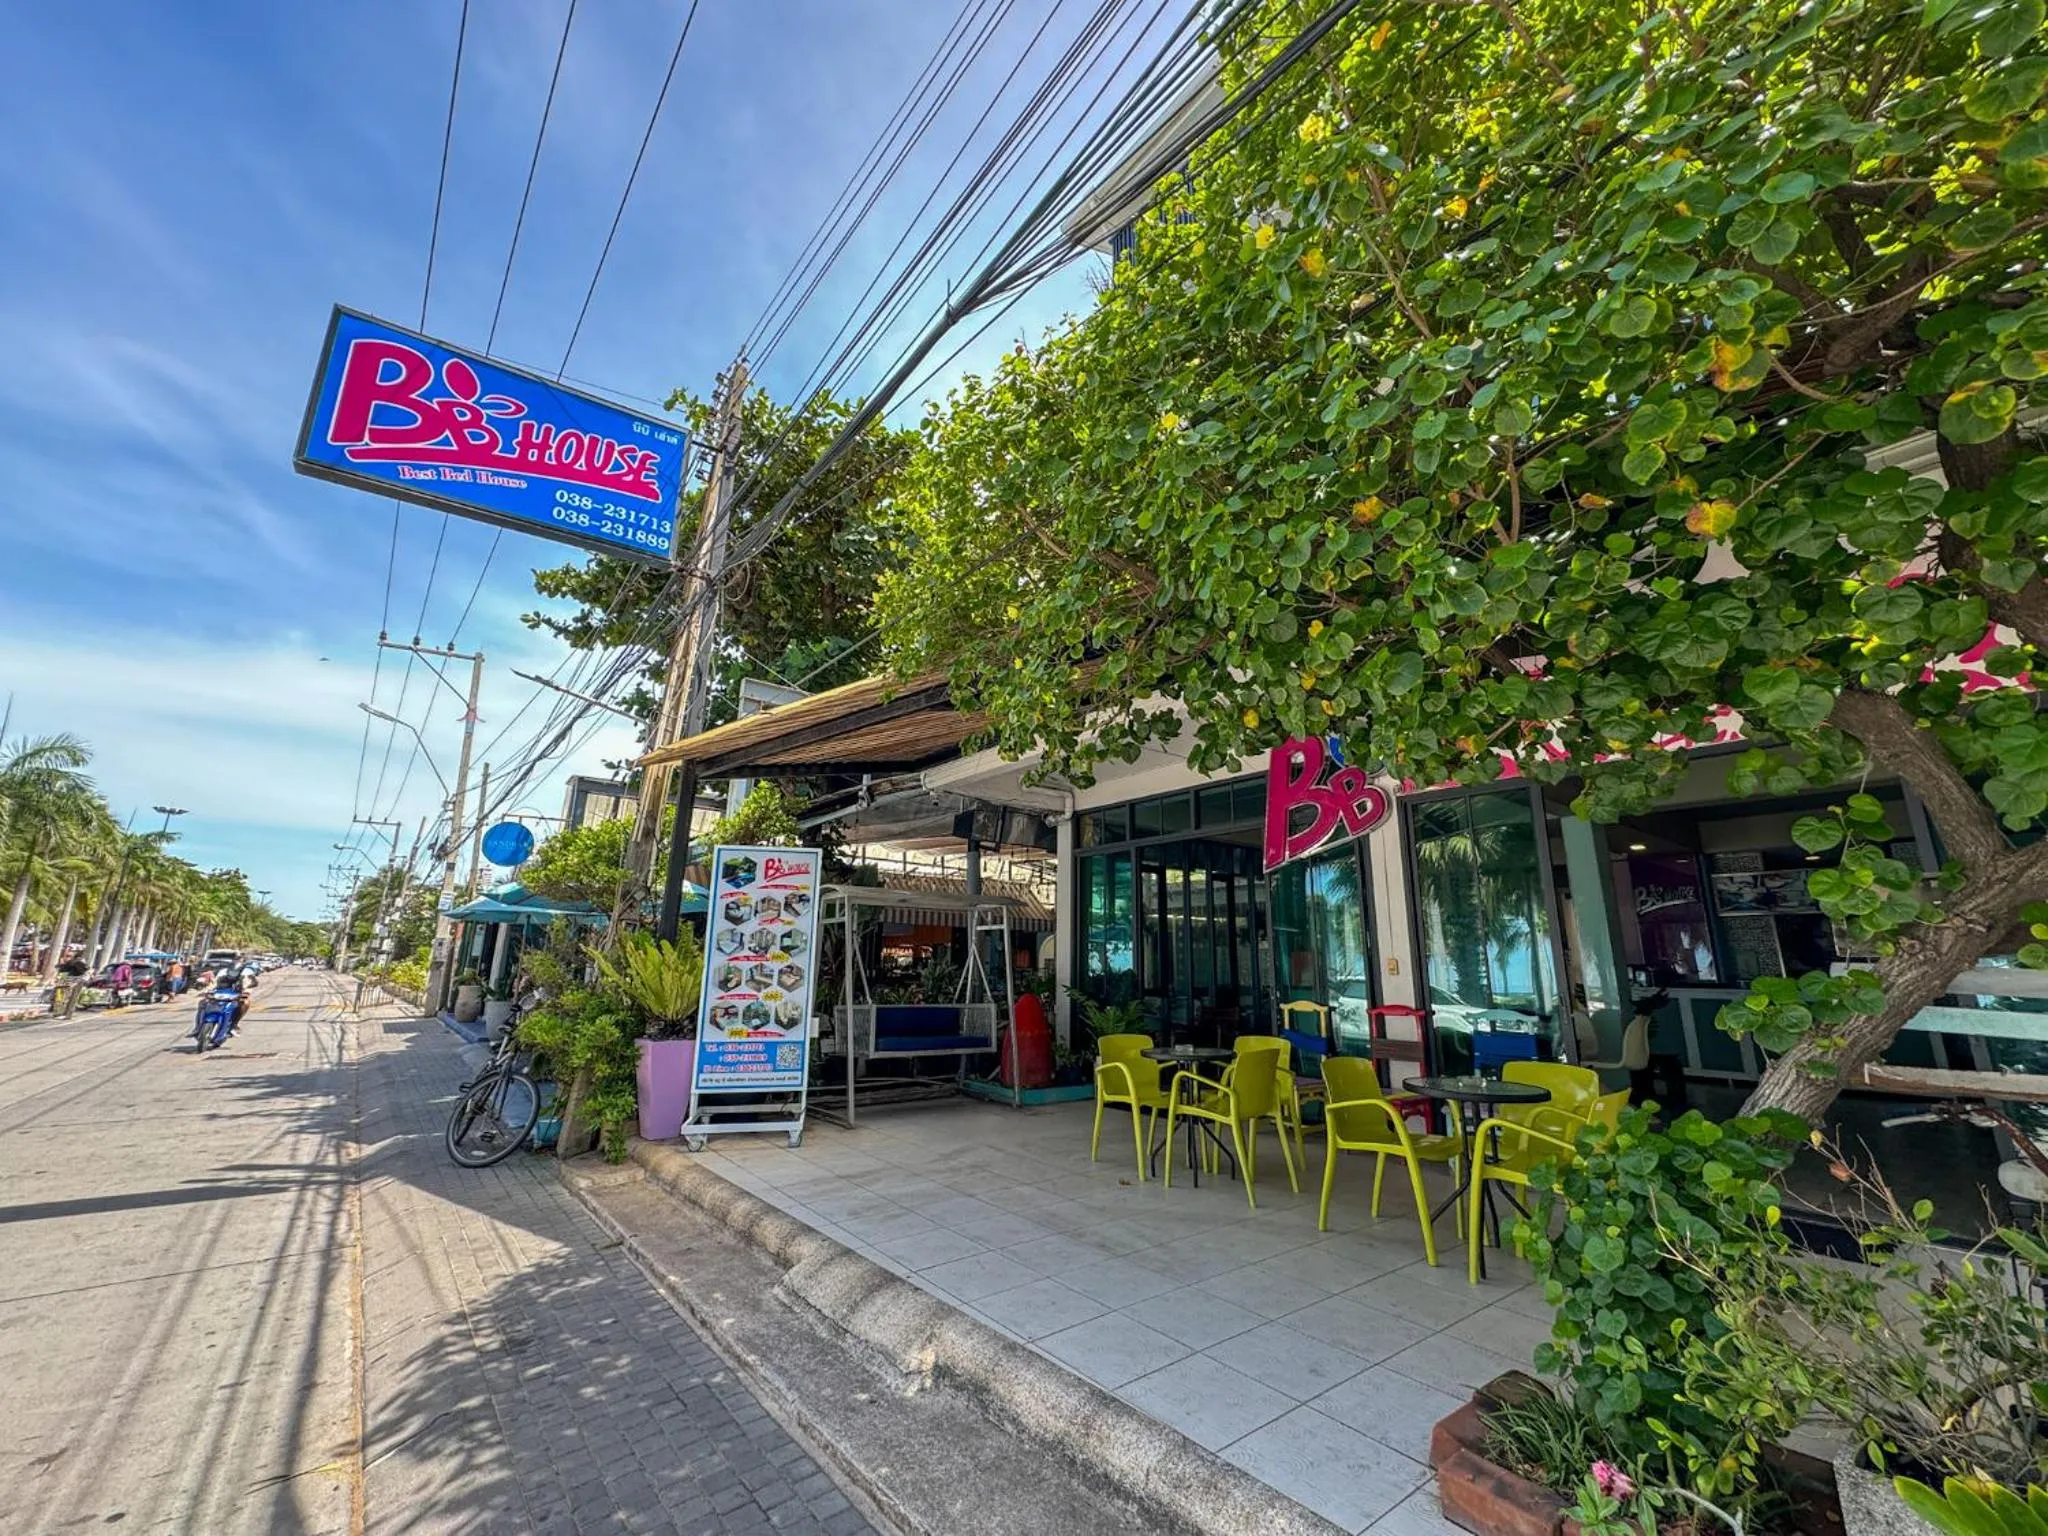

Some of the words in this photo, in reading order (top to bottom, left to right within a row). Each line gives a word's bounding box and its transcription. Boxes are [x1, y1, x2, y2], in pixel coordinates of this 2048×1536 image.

[397, 465, 438, 480] Best
[439, 467, 473, 483] Bed
[475, 470, 528, 489] House
[513, 421, 662, 489] HOUSE
[552, 506, 670, 550] 038-231889
[555, 489, 672, 534] 038-231713
